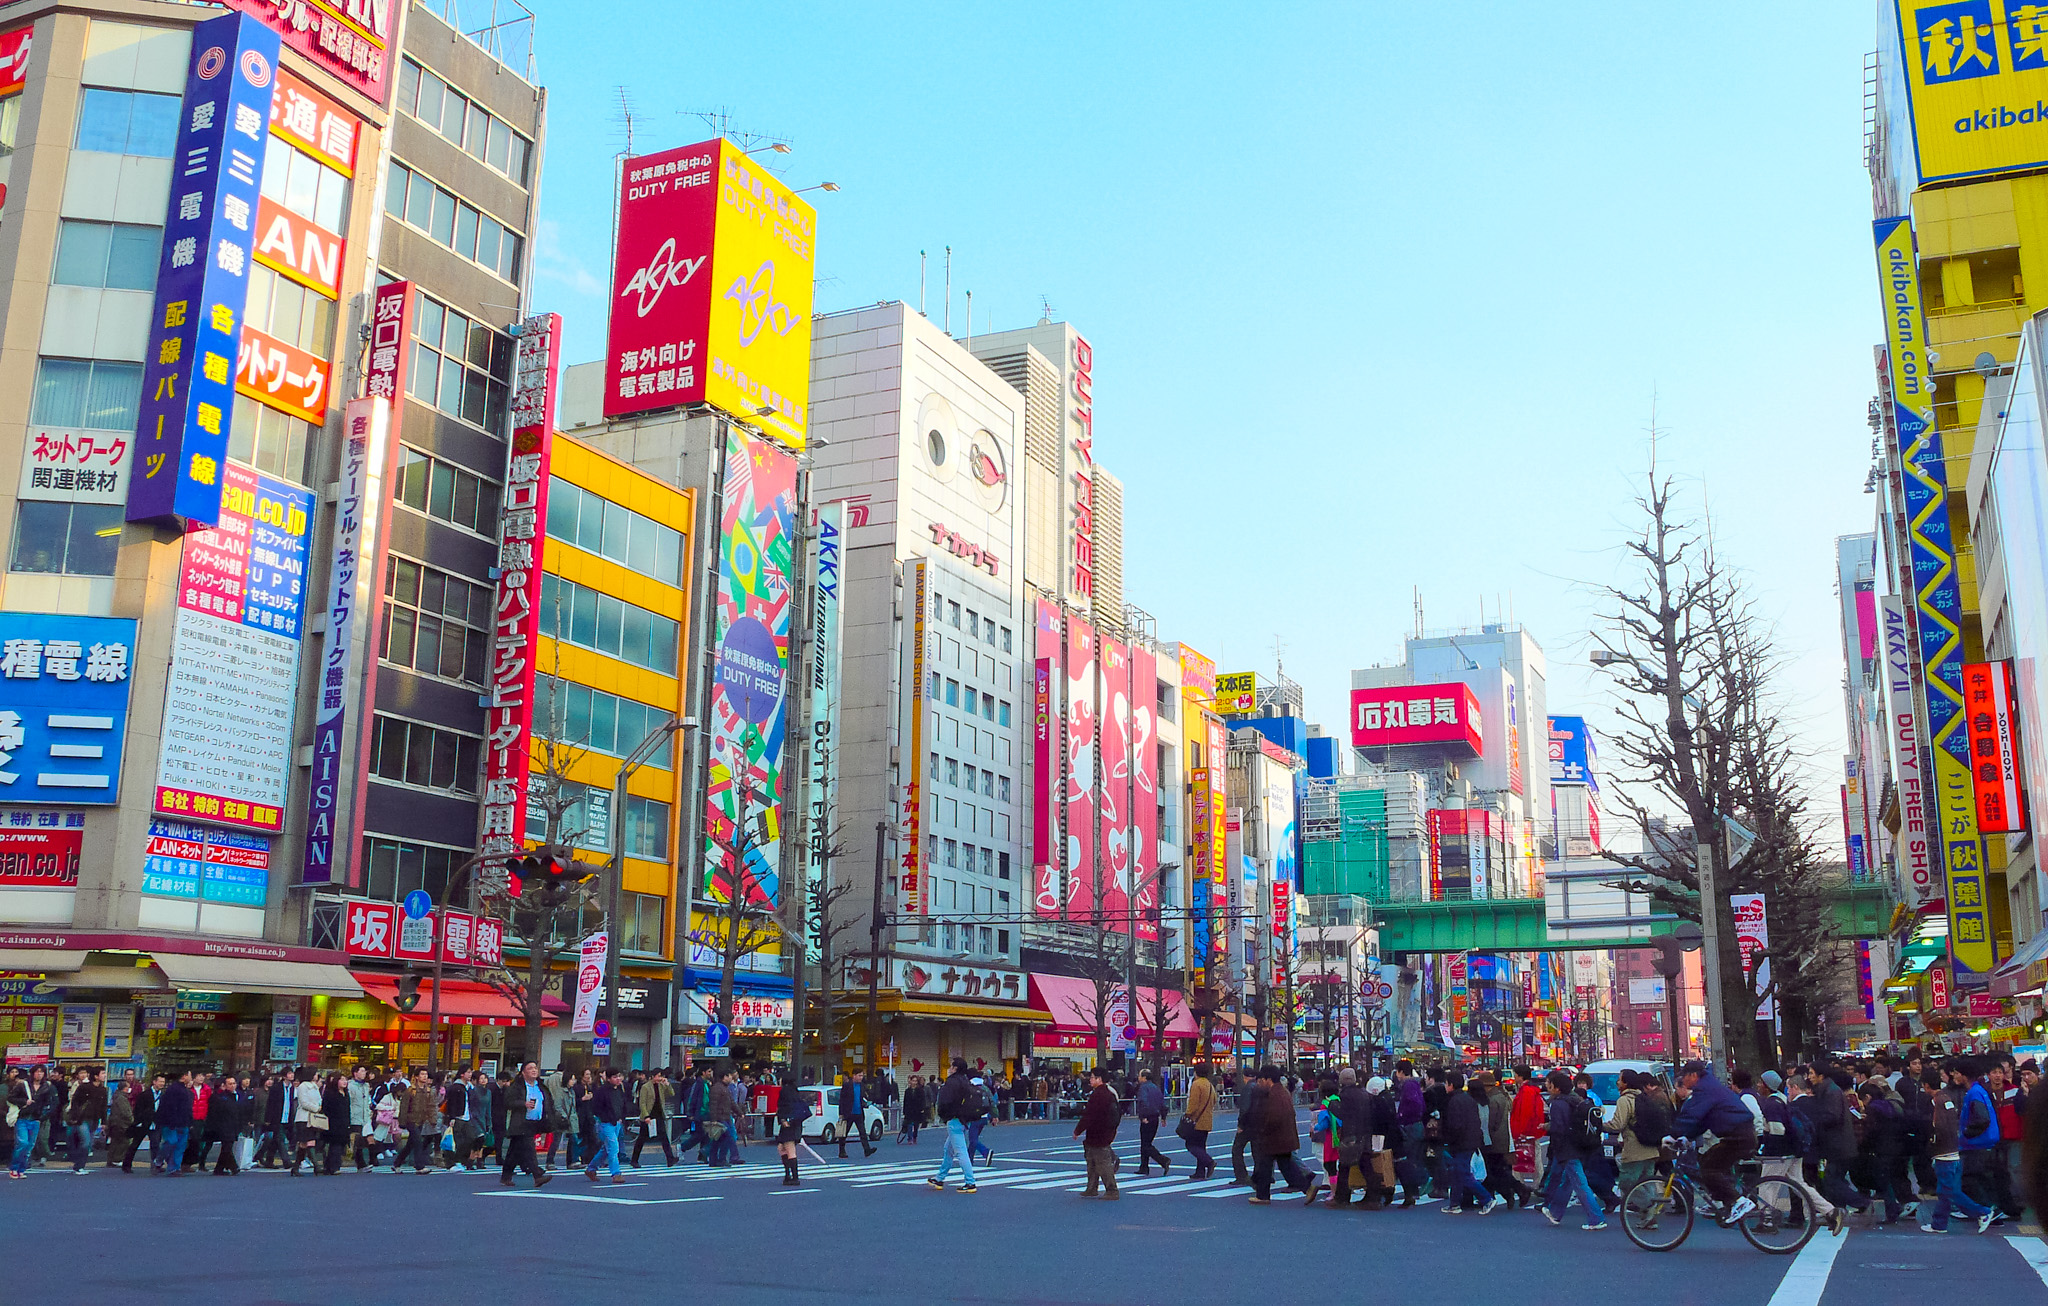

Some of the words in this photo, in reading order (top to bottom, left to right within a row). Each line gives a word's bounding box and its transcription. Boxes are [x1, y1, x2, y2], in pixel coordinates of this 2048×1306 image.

[270, 79, 353, 165] 通信
[171, 100, 216, 269] 愛三電機
[628, 182, 668, 200] DUTY
[674, 171, 711, 193] FREE
[630, 154, 712, 183] 秋葉原免税中心
[217, 103, 262, 278] 愛三電機
[725, 156, 811, 236] 秋葉原免税中心
[723, 184, 766, 227] DUTY
[773, 221, 809, 261] FREE
[254, 214, 339, 286] AN
[621, 255, 707, 297] AKKY
[723, 274, 801, 337] AKKY
[1889, 248, 1920, 395] akibakan.com
[369, 293, 404, 397] 坂口電熱
[620, 339, 696, 374] 海外向け
[145, 299, 188, 479] 配線パーツ
[190, 302, 235, 486] 各種電線
[619, 365, 694, 398] 電気製品
[712, 354, 804, 427] 海外向け電気製品
[1075, 335, 1093, 467] DUTY
[32, 432, 127, 466] ネットワーク
[31, 467, 118, 493] 関連機材
[1908, 489, 1928, 501] モニタ
[256, 527, 305, 552] 光ファイバー
[1075, 470, 1093, 598] FREE
[1923, 522, 1944, 534] プリンタ
[254, 546, 302, 576] 無線LAN
[323, 415, 368, 709] 各種ケーブル・ネットワーク機器
[818, 518, 839, 600] AKKY
[929, 522, 999, 576] ナカウラ
[1915, 561, 1938, 571] スキャナ
[188, 569, 240, 597] ネットワーク管理
[251, 587, 298, 614] セキュリティ
[915, 569, 925, 624] NAKAURA
[1936, 590, 1953, 598] デジ
[1937, 600, 1954, 608] カメ
[186, 588, 238, 618] 各種電線
[248, 606, 297, 633] 配線部材
[184, 614, 213, 628] フジクラ
[220, 624, 250, 639] 住友電工
[257, 635, 294, 651] 三菱電線工業
[814, 588, 827, 691] INTERNATIONAL
[914, 630, 923, 658] MAIN
[1884, 606, 1909, 679] AKKY
[1924, 631, 1946, 642] ドライブ
[178, 657, 206, 671] NTT-AT
[209, 665, 239, 679] NTT-ME
[180, 643, 216, 658] コーニング
[223, 653, 264, 670] 三菱レーヨン
[724, 646, 780, 678] 秋葉原免税中心
[214, 680, 249, 695] YAMAHA
[256, 690, 288, 705] Panasonic
[724, 665, 752, 687] DUTY
[754, 677, 779, 699] FREE
[913, 662, 922, 701] STORE
[1944, 671, 1961, 680] カード
[1972, 673, 1988, 703] 牛丼
[175, 686, 197, 698] サクサ
[205, 692, 247, 709] 日本ビクター
[1357, 697, 1458, 730] 石丸電気
[1930, 700, 1951, 708] ネット
[1932, 708, 1952, 717] ワーク
[171, 715, 224, 731] アライドテレシス
[228, 726, 266, 741] バッファロー
[271, 736, 285, 746] PCI
[172, 700, 197, 712] CISCO
[266, 721, 286, 732] 3Com
[167, 743, 187, 754] AMP
[193, 749, 221, 762] レイケム
[227, 755, 255, 768] Panduit
[261, 762, 282, 773] Molex
[169, 729, 205, 744] NETGEAR
[211, 738, 232, 749] コレガ
[237, 742, 263, 756] オムロン
[268, 750, 284, 760] APC
[813, 721, 832, 785] DUTY
[1897, 713, 1918, 770] DUTY
[1973, 712, 1998, 783] 吉野家
[166, 758, 197, 772] 松下電工
[206, 766, 229, 777] ヒロセ
[164, 773, 187, 785] Fluke
[195, 778, 221, 791] HIOKI
[229, 784, 268, 800] モリテックス
[309, 729, 337, 866] AISAN
[1948, 772, 1971, 835] ここが
[1983, 792, 2000, 807] 24
[161, 790, 189, 811] 各社
[193, 795, 220, 816] 特約
[223, 801, 250, 821] 在庫
[252, 805, 278, 825] 直販
[1194, 789, 1207, 825] ビデオ
[1903, 778, 1924, 832] FREE
[901, 781, 919, 892] ナカウラ本店
[1910, 840, 1932, 898] SHO
[1952, 843, 1984, 941] 秋葉館
[204, 943, 287, 957] http://www.aisan.co.jp
[349, 907, 500, 964] 坂電熱
[942, 967, 1020, 999] ナカウラ
[1931, 969, 1947, 1008] 免税店
[708, 999, 783, 1018] 秋原免税中心
[1971, 997, 1999, 1006] ラーメン
